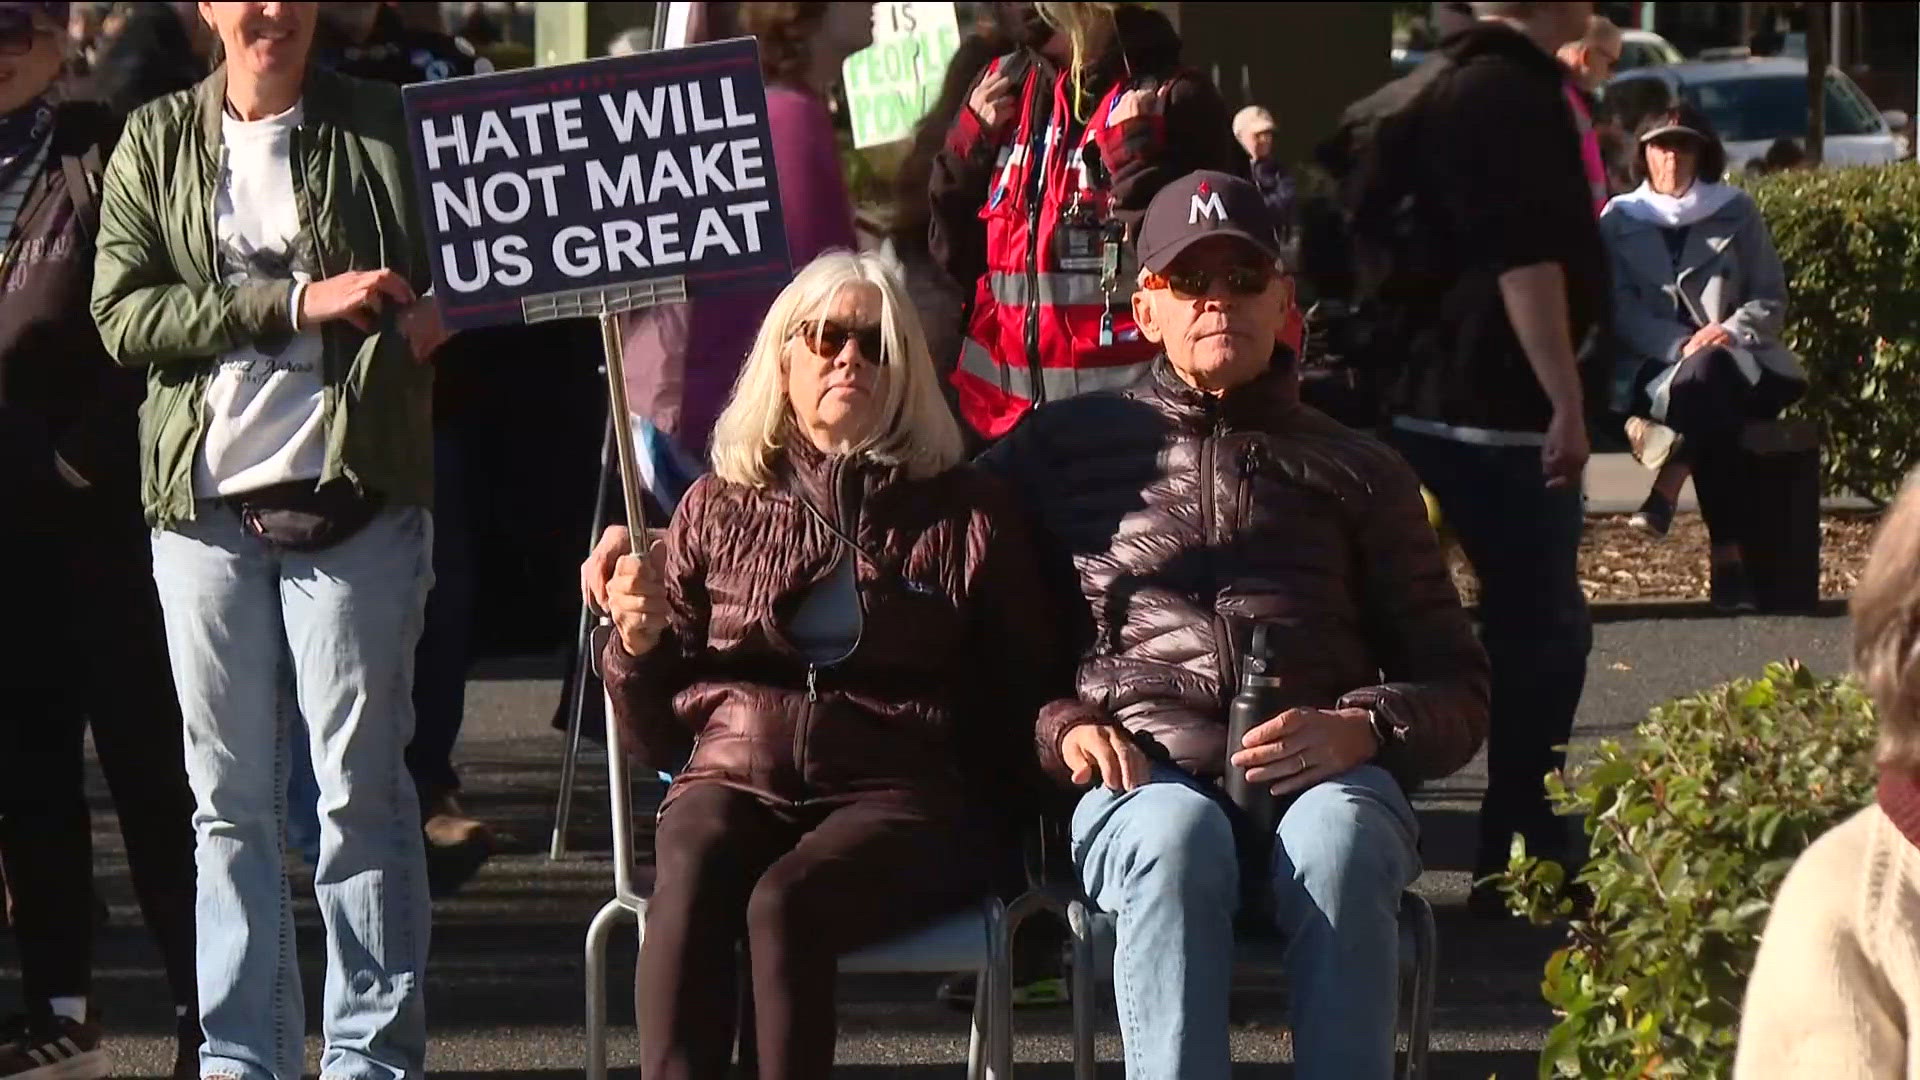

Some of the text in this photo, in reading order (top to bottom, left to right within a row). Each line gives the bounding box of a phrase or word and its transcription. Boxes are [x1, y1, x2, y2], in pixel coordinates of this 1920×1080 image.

[890, 2, 917, 33] IS
[849, 24, 956, 91] PEOPLE
[421, 77, 757, 170] HATE WILL
[855, 84, 928, 143] POW
[431, 137, 766, 233] NOT MAKE
[1188, 192, 1229, 224] M
[441, 200, 770, 292] US GREAT
